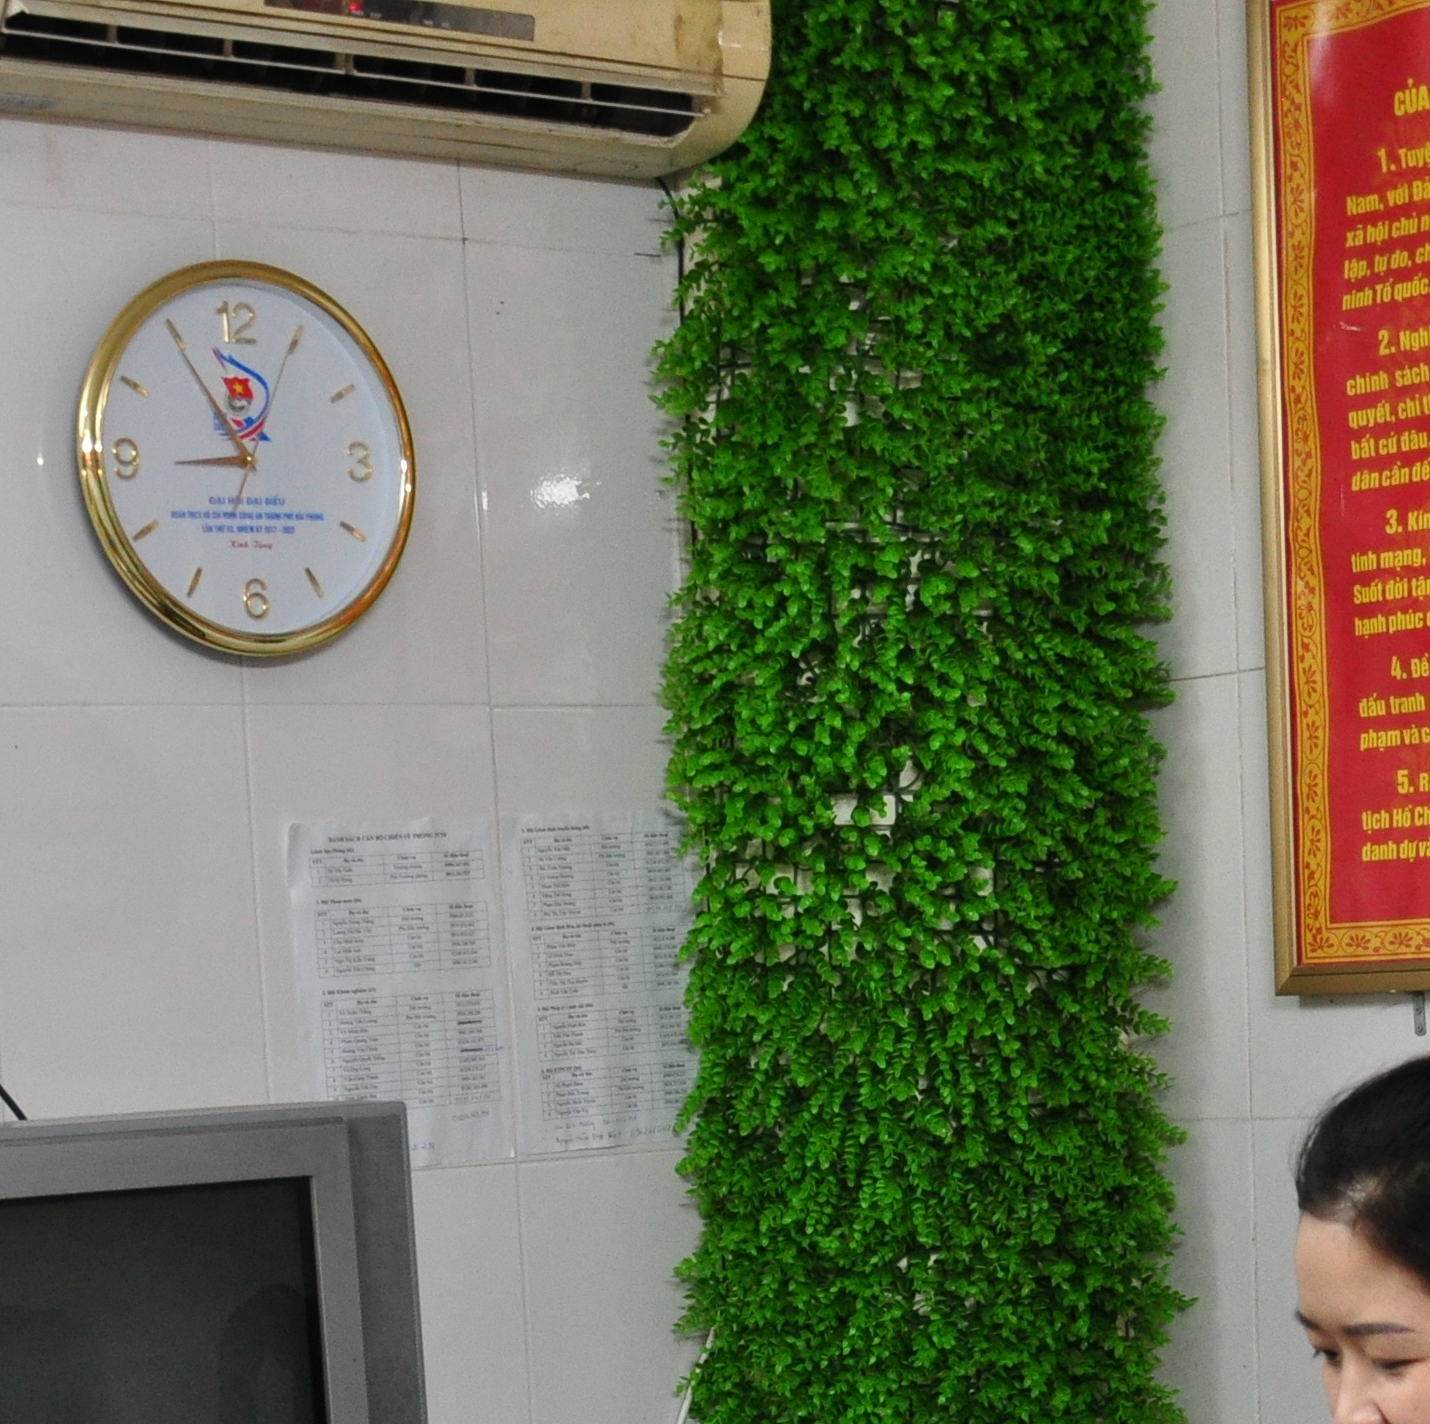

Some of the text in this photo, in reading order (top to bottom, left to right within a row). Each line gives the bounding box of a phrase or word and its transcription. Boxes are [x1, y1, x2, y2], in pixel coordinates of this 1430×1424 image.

[1394, 79, 1430, 115] CỦA
[1377, 148, 1395, 172] 1.
[214, 299, 258, 345] 12
[1378, 329, 1395, 355] 2.
[111, 437, 140, 481] 9
[347, 440, 374, 483] 3
[242, 577, 270, 620] 6
[1391, 656, 1406, 679] 4.
[1411, 653, 1429, 677] Đề
[1359, 693, 1385, 716] đấu
[1389, 693, 1425, 713] tranh
[1397, 769, 1413, 793] 5.
[1362, 841, 1396, 860] danh
[1399, 839, 1416, 861] dự
